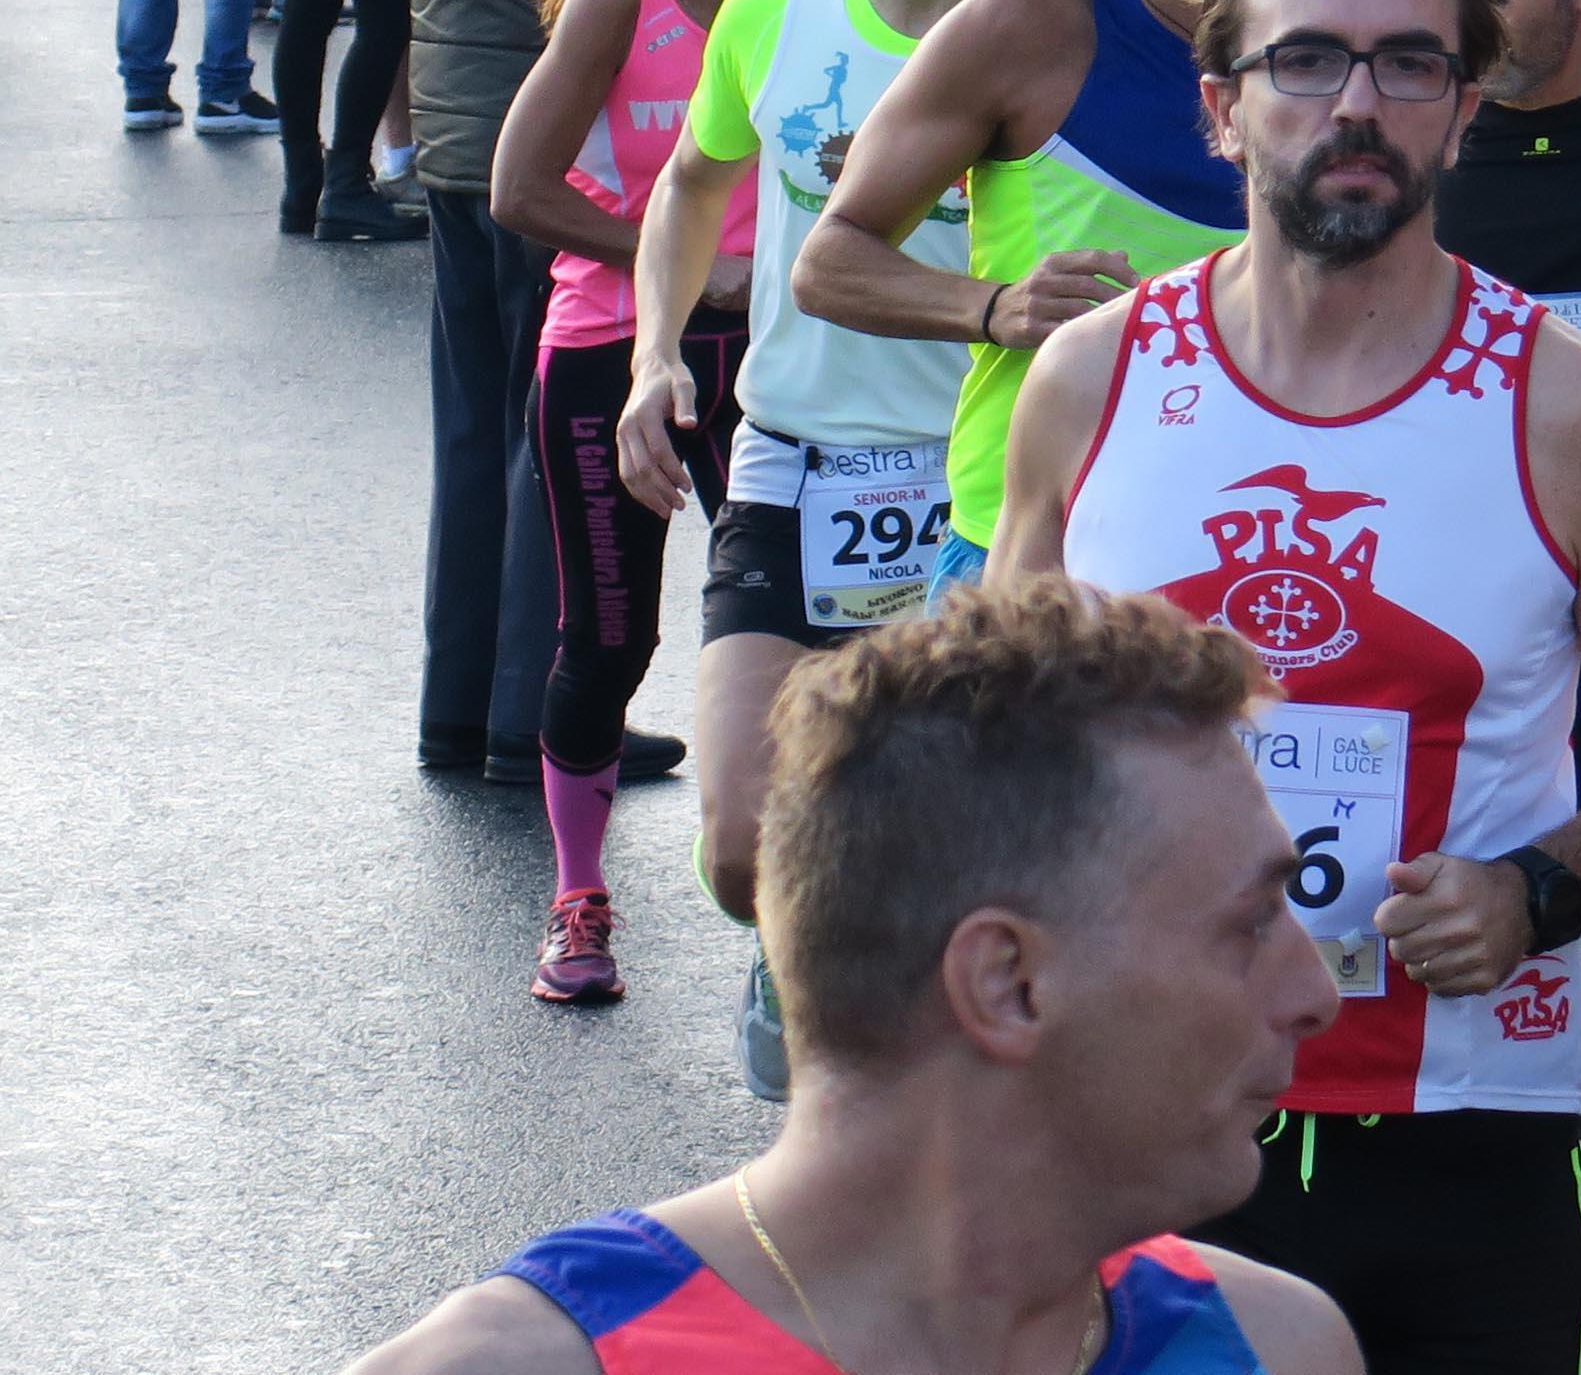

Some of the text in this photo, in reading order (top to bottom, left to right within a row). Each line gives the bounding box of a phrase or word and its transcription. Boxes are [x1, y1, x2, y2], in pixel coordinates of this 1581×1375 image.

[836, 447, 916, 476] estra
[853, 488, 926, 506] SENIOR-M
[830, 501, 951, 566] 294
[1202, 509, 1379, 588] PISA
[868, 563, 923, 580] NICOLA
[1320, 630, 1356, 659] Club
[1333, 736, 1370, 755] GAS
[1332, 757, 1384, 775] LUCE
[1285, 825, 1345, 909] 6
[1494, 992, 1571, 1040] PISA
